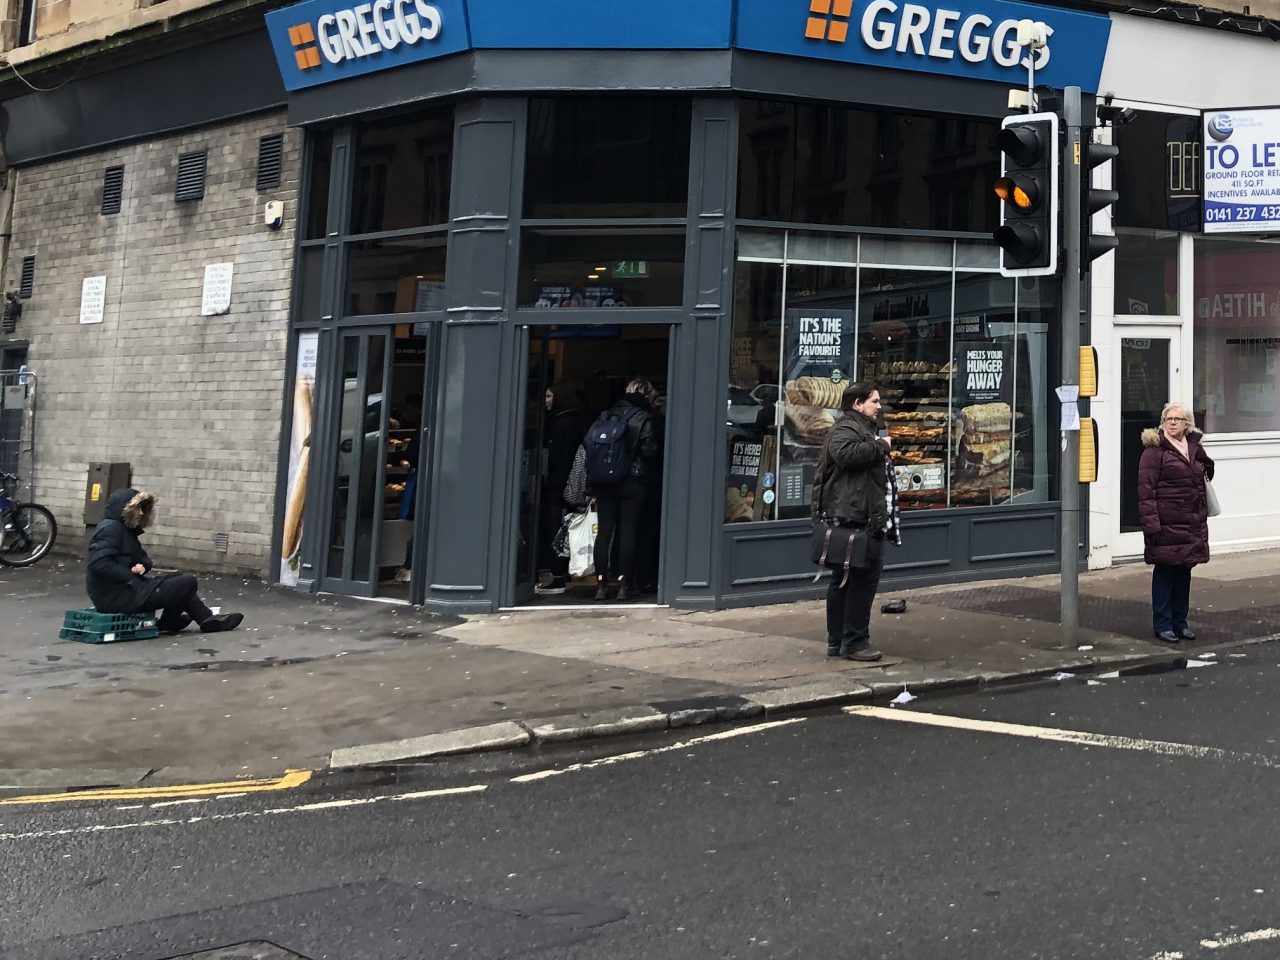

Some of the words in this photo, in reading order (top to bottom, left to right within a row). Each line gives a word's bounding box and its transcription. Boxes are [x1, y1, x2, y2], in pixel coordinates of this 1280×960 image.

[1206, 144, 1239, 169] TO
[1205, 171, 1238, 180] GROUND
[1241, 170, 1264, 178] FLOOR
[1231, 180, 1241, 188] 411
[1208, 189, 1248, 198] INCENTIVES
[1206, 207, 1232, 221] 0141
[1236, 207, 1257, 220] 237
[800, 317, 820, 332] IT'S
[822, 318, 842, 333] THE
[799, 333, 841, 345] NATION'S
[798, 345, 841, 356] FAVOURITE
[966, 350, 986, 360] MELTS
[986, 350, 1003, 359] YOUR
[966, 360, 1003, 373] HUNGER
[966, 372, 1003, 390] AWAY
[733, 443, 744, 455] IT'S
